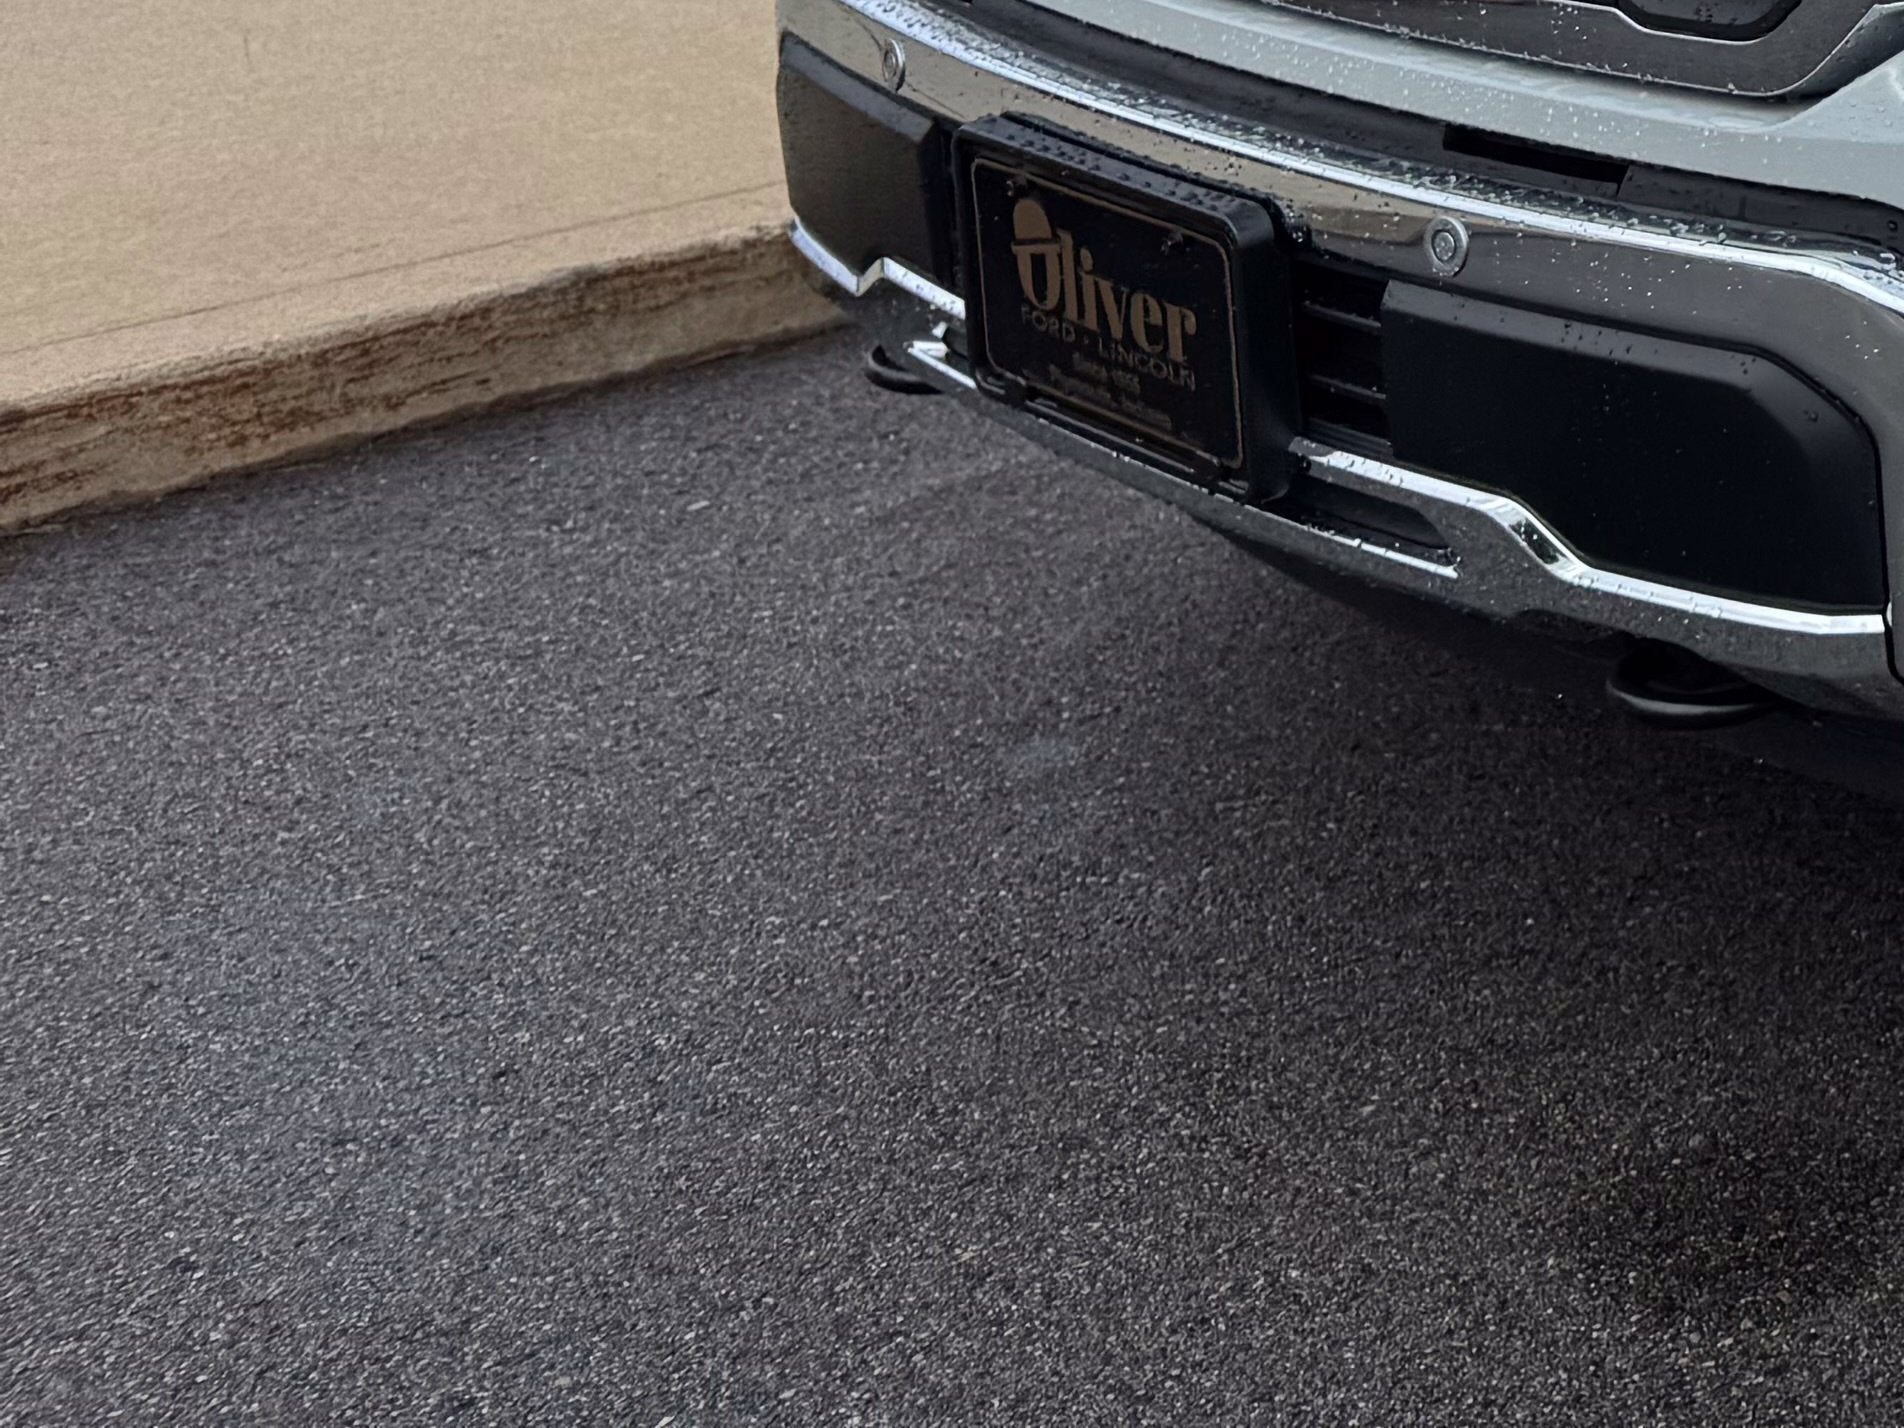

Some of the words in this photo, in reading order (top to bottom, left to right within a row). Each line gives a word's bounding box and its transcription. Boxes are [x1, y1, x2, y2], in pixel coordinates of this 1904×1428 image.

[1010, 199, 1198, 363] Oliver
[1021, 303, 1076, 344] FORD
[1098, 336, 1197, 392] LINCOLN
